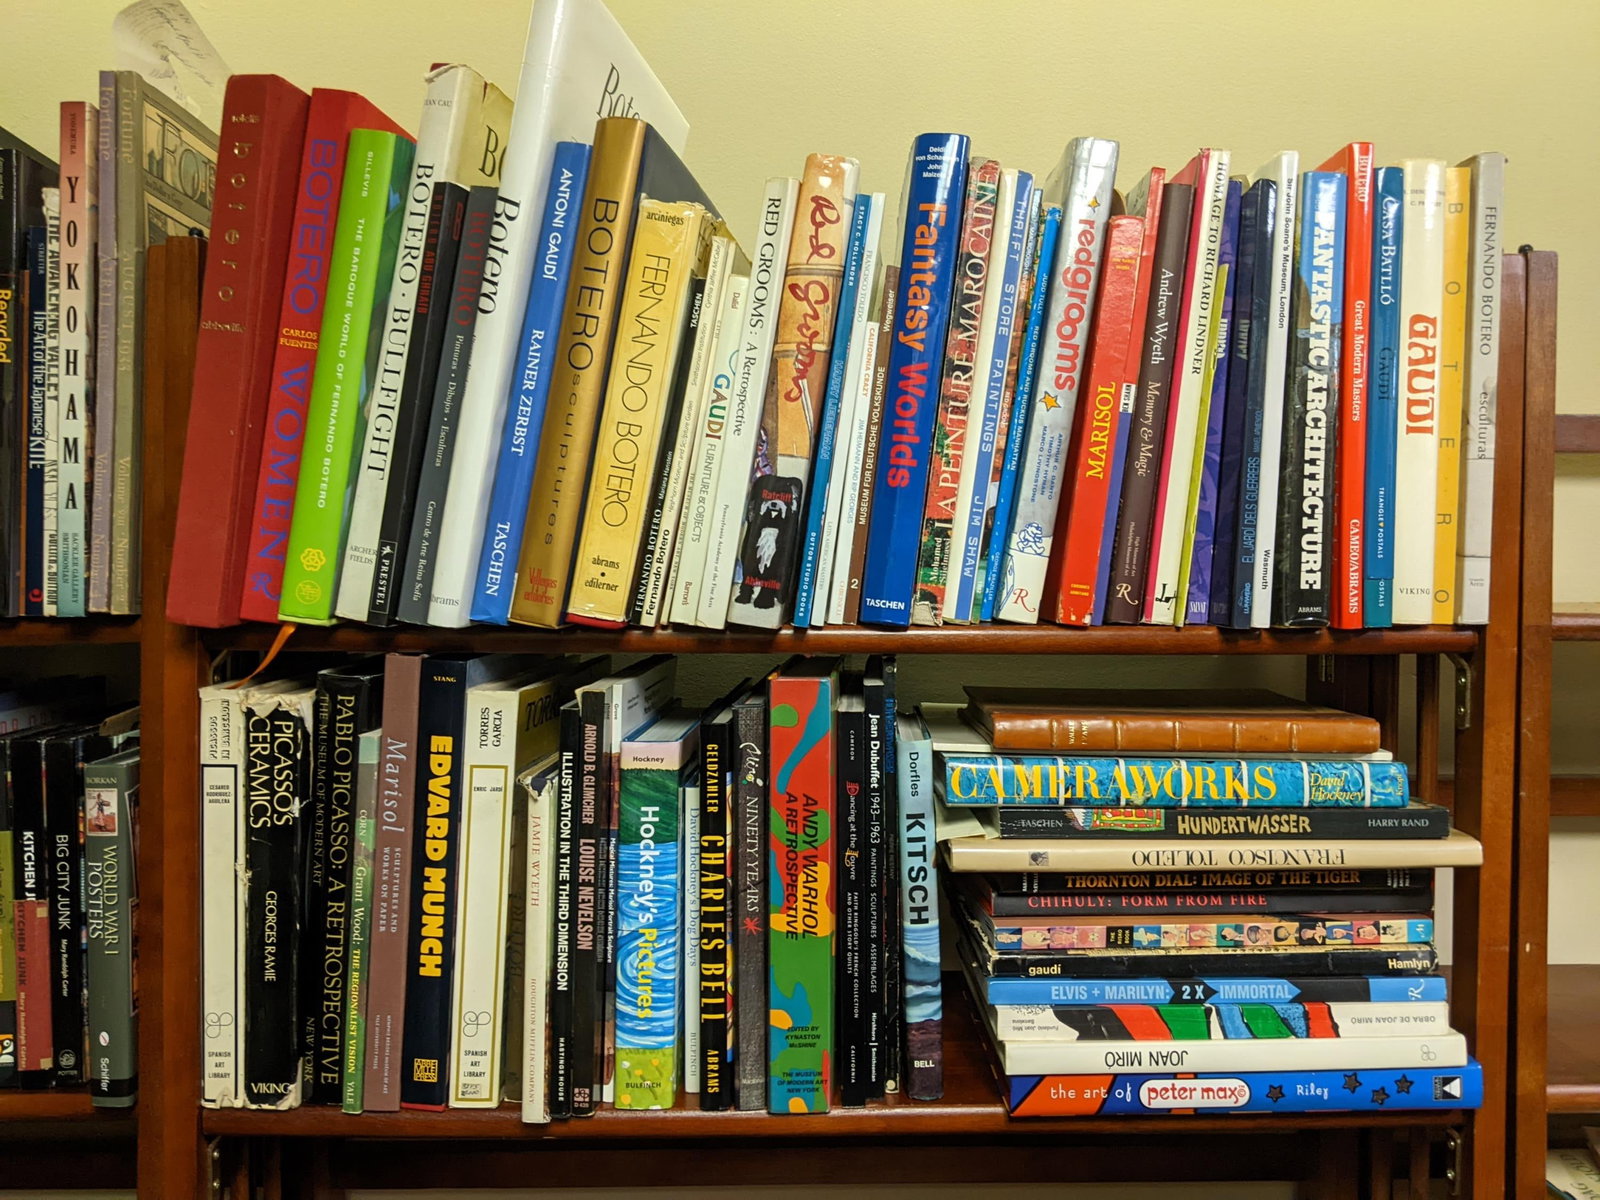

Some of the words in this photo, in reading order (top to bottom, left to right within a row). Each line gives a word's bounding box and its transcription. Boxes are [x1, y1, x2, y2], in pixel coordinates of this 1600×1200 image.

[361, 151, 373, 197] SILLEVIS
[552, 168, 574, 227] ANTONI
[290, 139, 337, 315] BOTERO
[355, 217, 366, 242] THE
[399, 162, 435, 285] BOTERO
[1008, 200, 1027, 262] THRIFT
[477, 195, 521, 314] Botero
[542, 232, 561, 281] GAUDÍ
[1482, 206, 1497, 290] FERNANDO
[345, 247, 360, 307] BAROQUE
[898, 202, 947, 352] Fantasy
[1157, 268, 1174, 319] Andrew
[1199, 247, 1216, 311] RICHARD
[33, 311, 48, 331] The
[998, 283, 1016, 337] STORE
[1037, 294, 1045, 315] TULLY
[1354, 300, 1365, 331] Great
[1479, 295, 1494, 355] BOTERO
[33, 332, 48, 351] Art
[339, 313, 352, 358] WORLD
[621, 253, 672, 412] FERNANDO
[1032, 326, 1040, 341] RED
[1149, 322, 1168, 365] Wyeth
[1190, 315, 1209, 375] LINDNER
[1352, 334, 1364, 375] Modern
[32, 365, 46, 383] the
[33, 352, 45, 363] of
[335, 363, 345, 379] OF
[522, 329, 545, 390] RAINER
[1025, 342, 1037, 375] GROOMS
[366, 304, 411, 481] BULLFIGHT
[733, 356, 757, 437] Retrospective
[981, 358, 1004, 453] PAINTINGS
[1023, 377, 1032, 392] AND
[1140, 381, 1161, 425] Memory
[1351, 377, 1363, 421] Masters
[31, 385, 45, 435] Japanese
[325, 384, 342, 453] FERNANDO
[511, 395, 534, 456] ZERBST
[886, 362, 929, 488] Worlds
[1017, 395, 1028, 424] RUCKUS
[1477, 392, 1490, 460] esculturas
[29, 437, 46, 469] KITE
[1010, 425, 1023, 470] MANHATTAN
[1141, 427, 1155, 441] &
[257, 361, 309, 564] WOMEN
[601, 421, 643, 527] BOTERO
[1135, 443, 1153, 477] Magic
[317, 457, 331, 509] BOTERO
[971, 496, 984, 526] JIM
[485, 522, 510, 596] TASCHEN
[807, 532, 816, 559] DUTTON
[963, 536, 978, 578] SHAW
[1348, 519, 1361, 614] CAMEO/ABRAMS
[375, 559, 390, 606] PRESTEL
[646, 567, 665, 616] Fernando
[657, 529, 671, 566] Botero
[802, 561, 813, 590] STUDIO
[1260, 549, 1272, 590] Wasmuth
[798, 592, 809, 617] BOOKS
[865, 597, 905, 610] TASCHEN
[319, 695, 329, 720] THE
[334, 694, 355, 765] PABLO
[479, 707, 489, 749] TORRES
[492, 710, 503, 748] GARCIA
[316, 724, 328, 780] MUSEUM
[583, 724, 597, 761] ARNOLD
[632, 756, 665, 764] Hockney
[248, 716, 271, 828] CERAMICS
[381, 737, 408, 833] Marisol
[583, 764, 596, 774] B.
[706, 744, 719, 813] GELDZAHLER
[909, 752, 921, 797] Dorfles
[316, 783, 326, 800] OF
[425, 735, 453, 861] EDVARD
[560, 752, 573, 836] ILLUSTRATION
[581, 775, 596, 824] GLIMCHER
[786, 792, 798, 804] A
[846, 780, 859, 823] Dancing
[313, 802, 326, 857] MODERN
[327, 770, 351, 870] PICASSO:
[802, 793, 818, 850] ANDY
[850, 824, 857, 832] at
[1021, 819, 1063, 828] TASCHEN
[1177, 814, 1312, 835] HUNDERTWASSER
[1367, 818, 1399, 828] HARRY
[1401, 818, 1429, 828] RAND
[21, 831, 35, 888] KITCHEN
[56, 834, 69, 858] BIG
[561, 841, 571, 854] IN
[579, 839, 595, 883] LOUISE
[844, 848, 859, 881] Louvre
[1132, 850, 1218, 866] TOLEDO
[56, 861, 70, 891] CITY
[312, 860, 323, 887] ART
[328, 877, 345, 893] A
[559, 857, 570, 881] THE
[608, 861, 616, 888] Mixtures:
[786, 807, 799, 941] RETROSPECTIVE
[905, 813, 929, 925] KITSCH
[1065, 875, 1150, 888] THORNTON
[1155, 875, 1198, 887] DIAL:
[1202, 873, 1251, 887] IMAGE
[1256, 872, 1275, 885] OF
[1278, 871, 1310, 884] THE
[1317, 871, 1360, 884] TIGER
[57, 894, 71, 930] JUNK
[87, 861, 103, 939] POSTERS
[558, 884, 570, 920] THIRD
[607, 888, 615, 909] Marisol
[700, 835, 725, 951] CHARLES
[802, 854, 818, 939] WARHOL
[1028, 896, 1112, 908] CHIHULY:
[1121, 895, 1168, 907] FORM
[1176, 895, 1222, 906] FROM
[1230, 895, 1267, 906] FIRE
[265, 891, 277, 943] GEORGES
[419, 866, 447, 977] MUNCH
[576, 886, 593, 950] NEVELSON
[60, 939, 68, 953] Mary
[60, 953, 70, 978] Randolph
[264, 946, 276, 982] RAMIE
[557, 923, 569, 991] DIMENSION
[606, 935, 614, 963] Sculpture
[61, 980, 69, 997] Carter
[320, 900, 345, 1085] RETROSPECTIVE
[701, 963, 725, 1023] BELL
[305, 1016, 315, 1046] NEW
[99, 1057, 110, 1091] Schiffer
[303, 1050, 315, 1083] YORK
[707, 1050, 719, 1093] ABRAMS
[913, 1060, 935, 1068] BELL
[250, 1082, 291, 1094] VIKING
